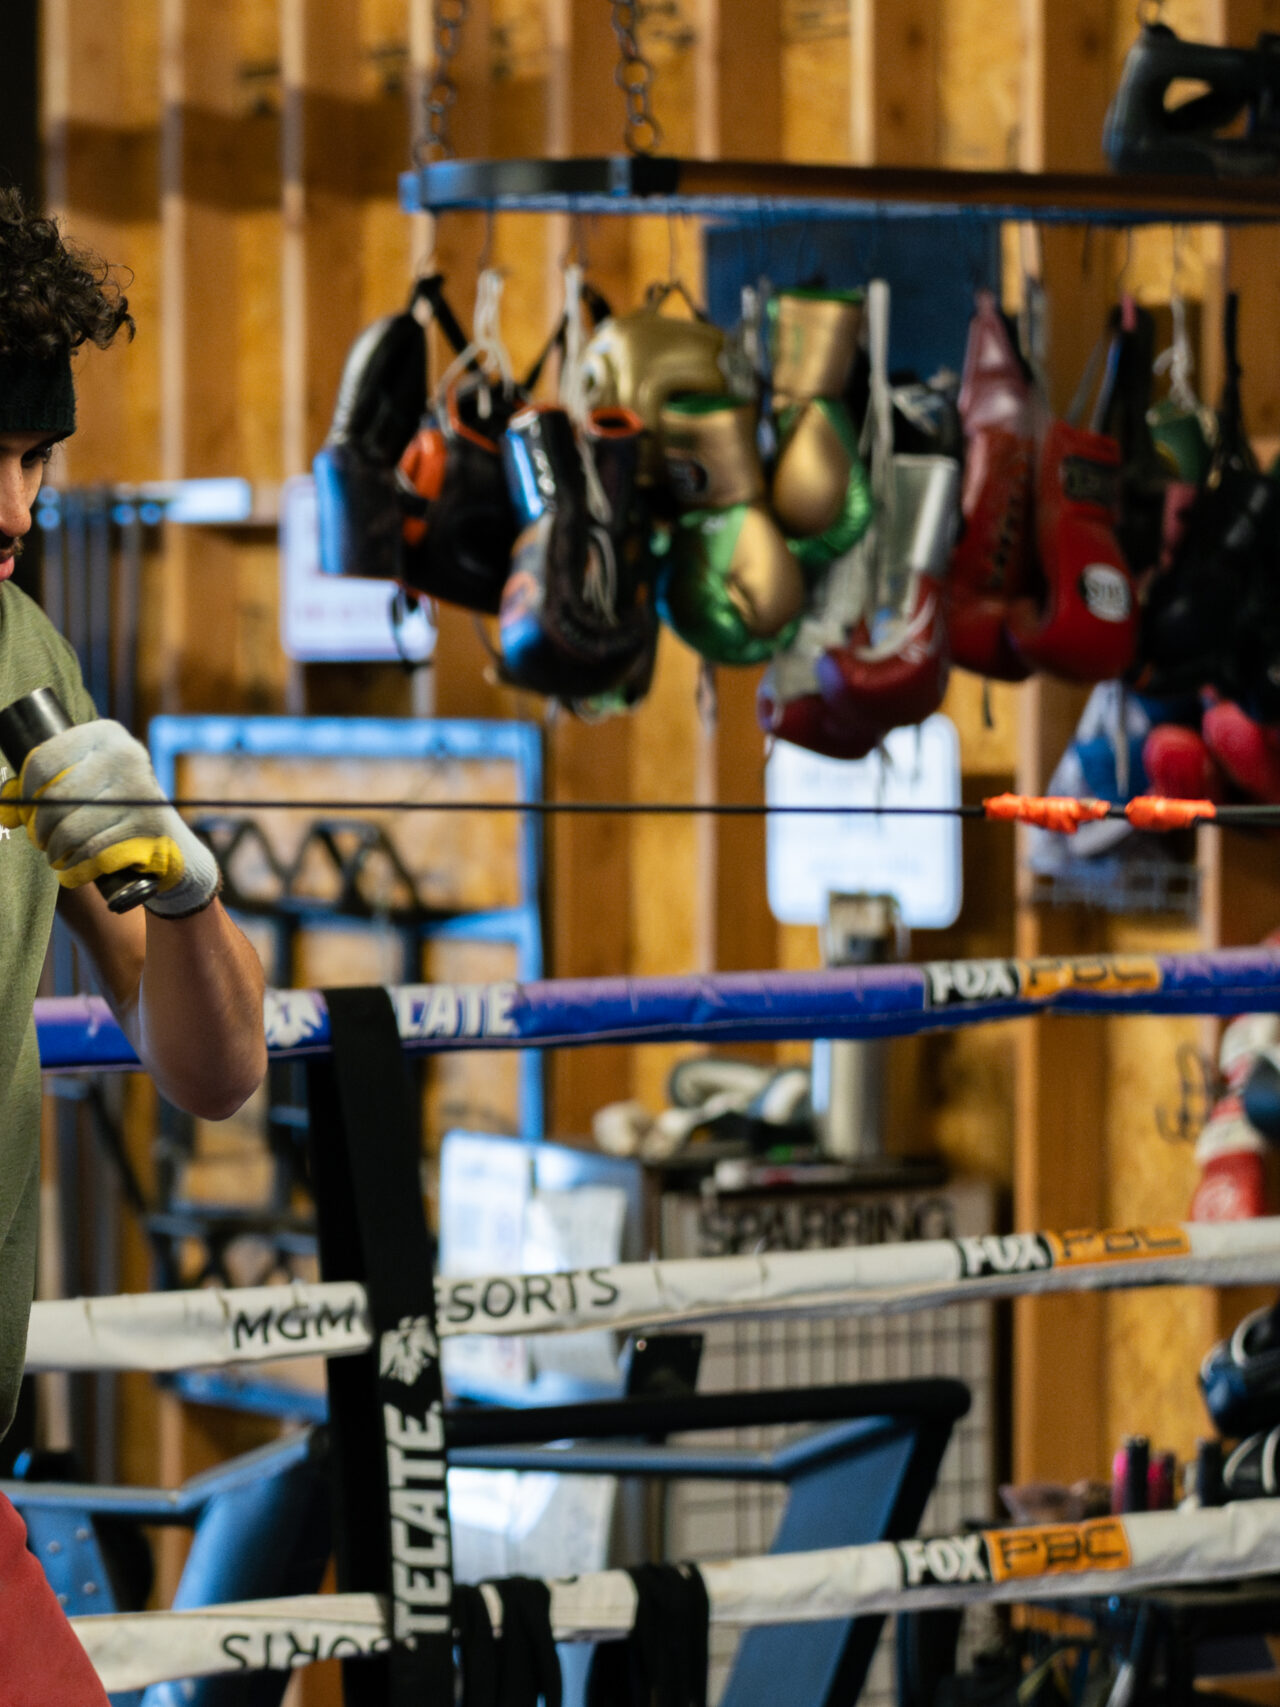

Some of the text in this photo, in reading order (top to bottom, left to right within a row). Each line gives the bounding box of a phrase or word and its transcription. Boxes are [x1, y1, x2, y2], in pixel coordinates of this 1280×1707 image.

[394, 983, 519, 1039] CATE
[233, 1267, 620, 1349] MGM SORTS
[384, 1401, 452, 1640] TECATE
[904, 1524, 1124, 1585] FOX PBC
